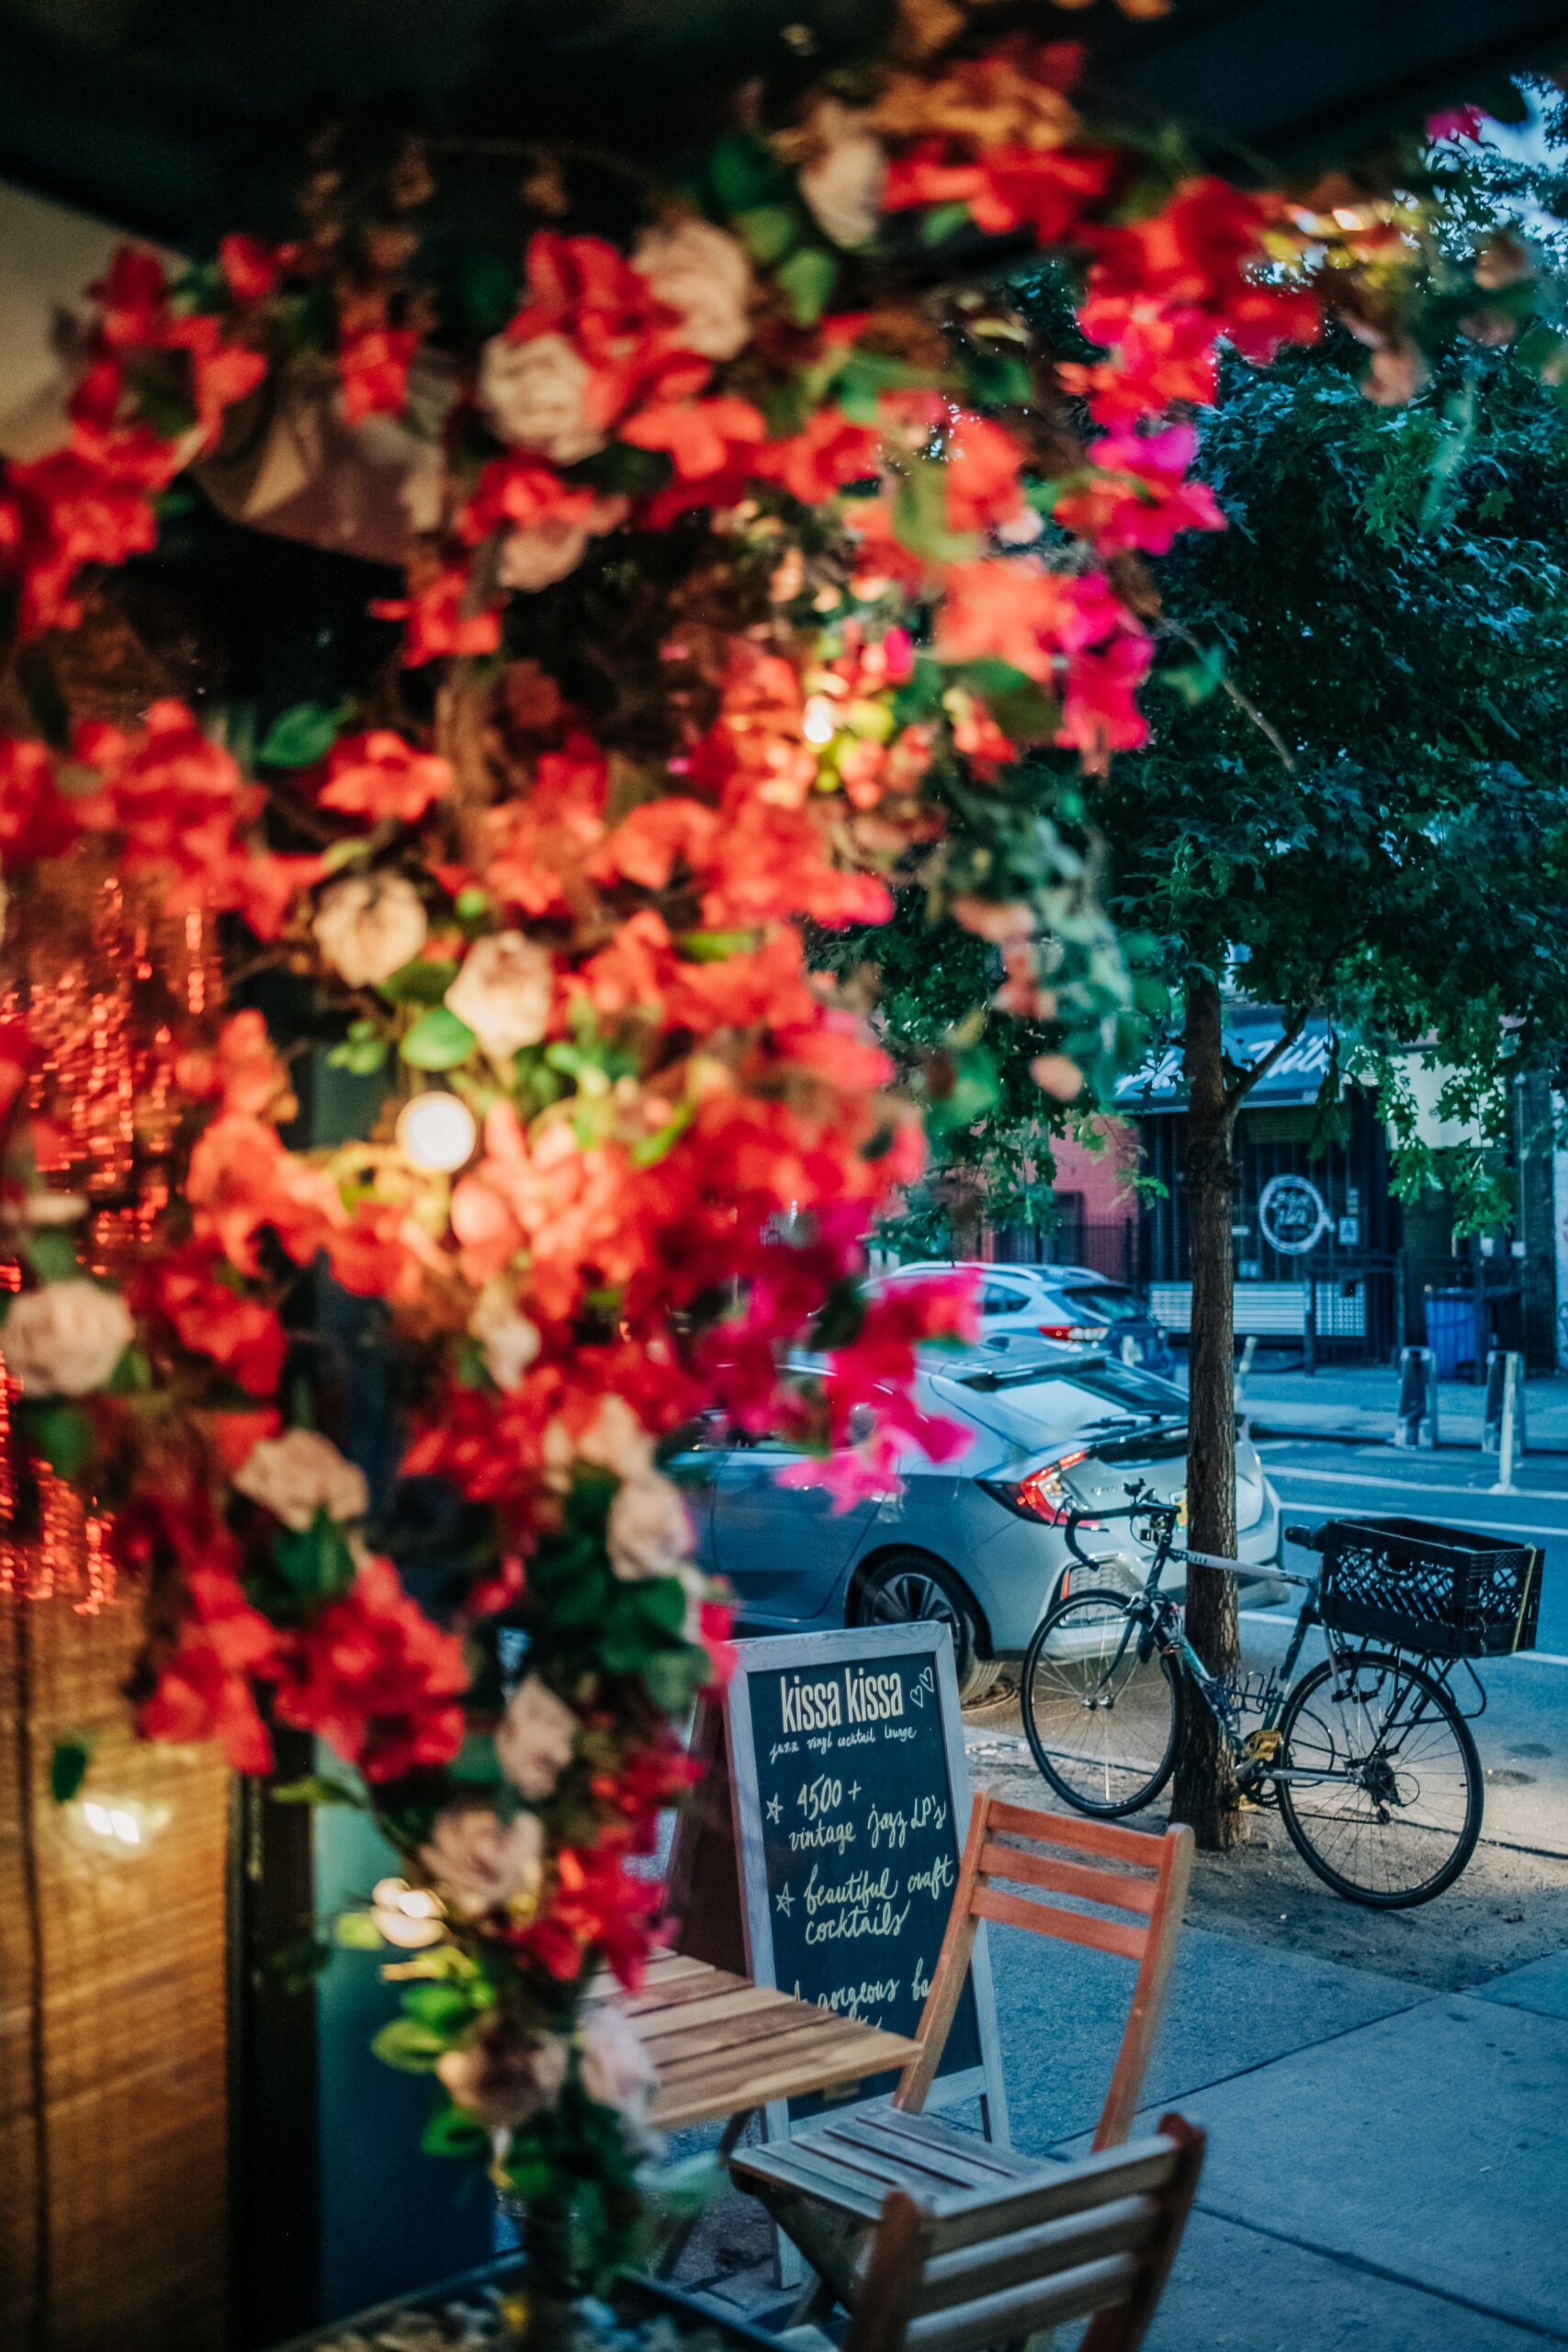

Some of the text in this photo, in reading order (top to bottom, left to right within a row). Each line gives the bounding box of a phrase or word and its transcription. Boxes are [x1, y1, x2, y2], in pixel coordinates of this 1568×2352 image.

[781, 1668, 904, 1734] kissa kissa
[770, 1741, 799, 1764] jazz
[807, 1731, 833, 1755] vinyl
[838, 1727, 875, 1747] cocktail
[789, 1794, 947, 1855] vintage jazz LP's
[804, 1853, 953, 1916] beautiful craft
[806, 1899, 911, 1945] cocktails
